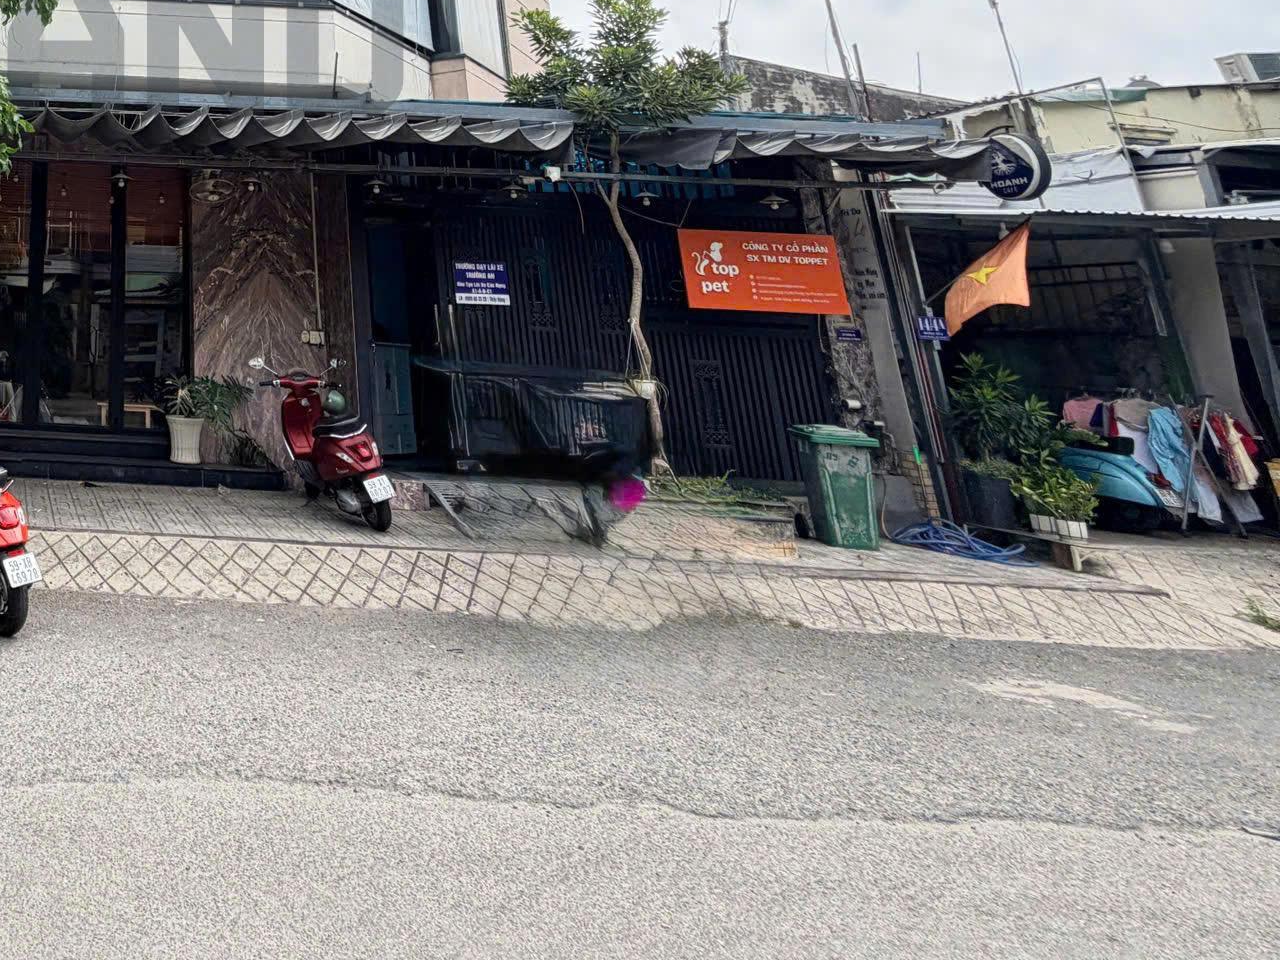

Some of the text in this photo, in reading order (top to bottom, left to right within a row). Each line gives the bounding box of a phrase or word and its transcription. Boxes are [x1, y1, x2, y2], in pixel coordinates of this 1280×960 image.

[771, 243, 784, 251] TY
[746, 254, 759, 262] SX
[762, 255, 777, 263] TM
[792, 257, 828, 265] TOPPET
[711, 262, 740, 278] top
[701, 280, 731, 295] pet
